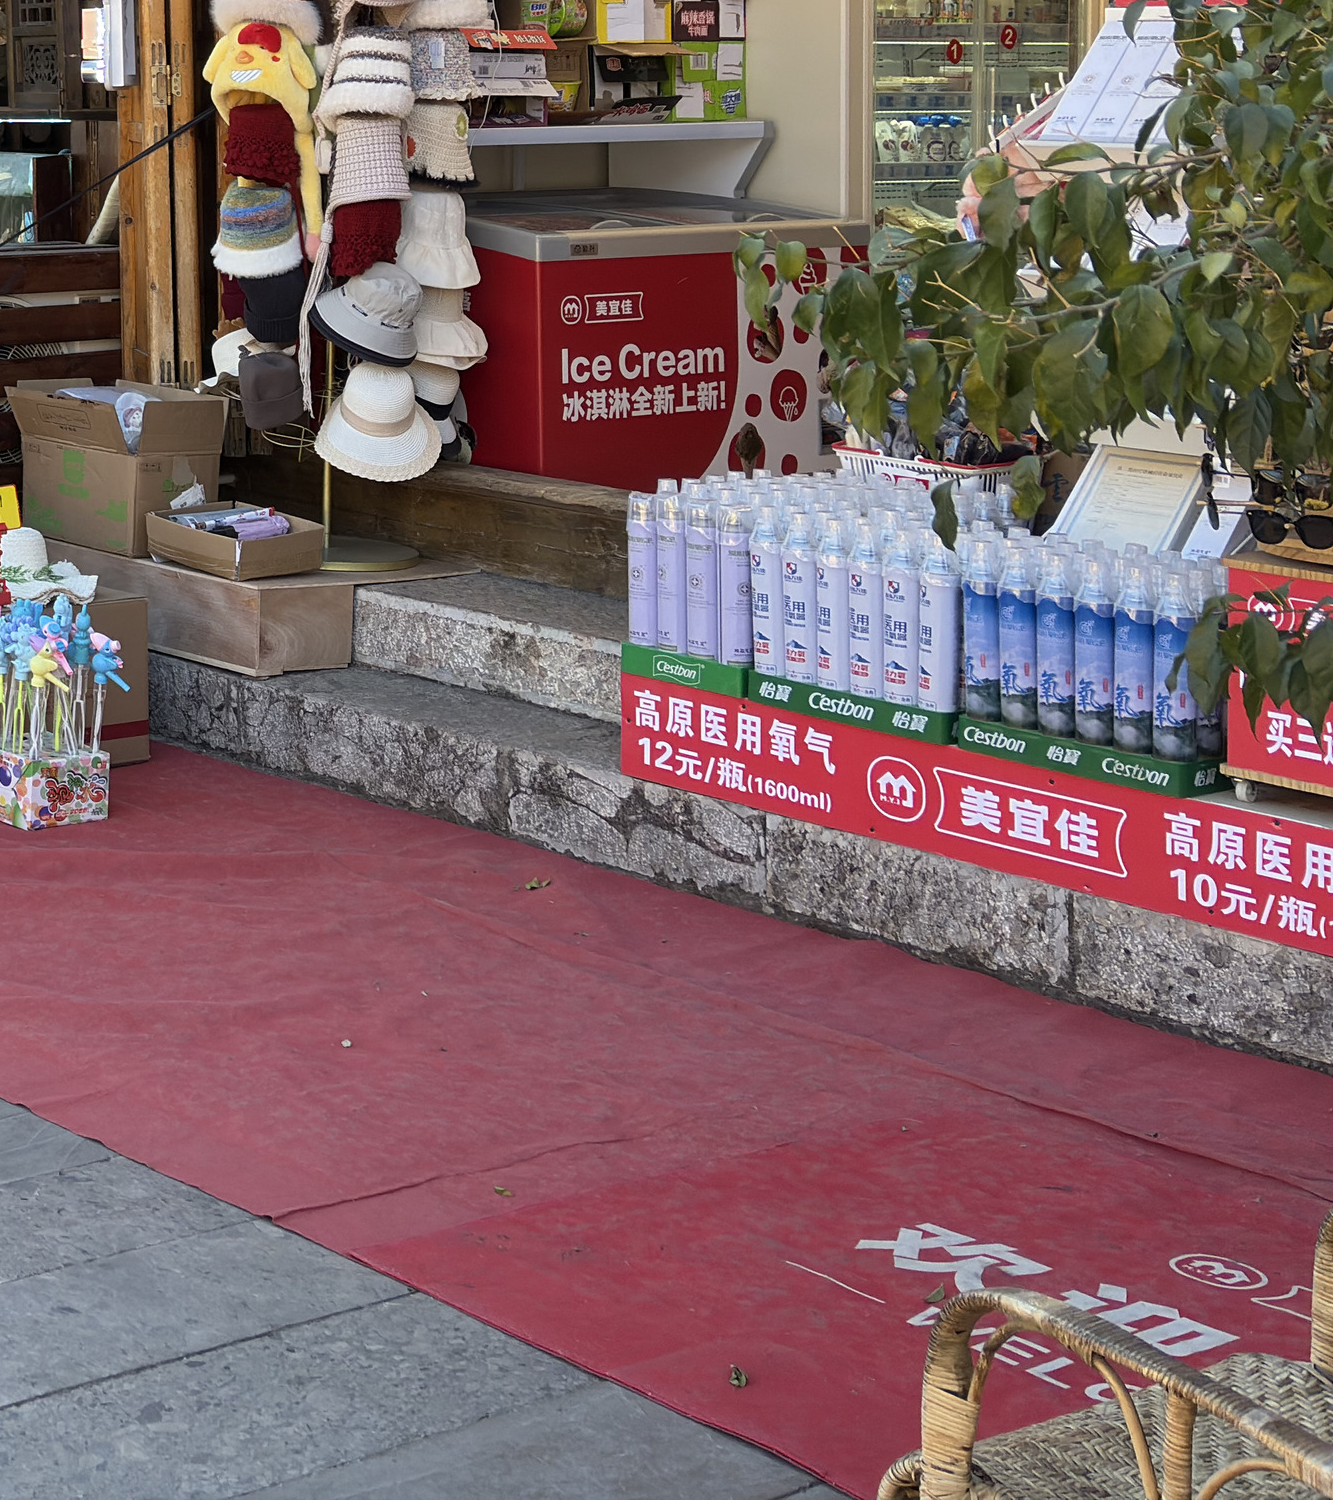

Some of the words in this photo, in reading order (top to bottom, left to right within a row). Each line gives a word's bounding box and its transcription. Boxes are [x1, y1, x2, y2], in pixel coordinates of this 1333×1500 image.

[680, 10, 715, 25] 麻辣香锅
[688, 25, 709, 37] 牛肉面
[950, 45, 959, 60] 1
[1004, 28, 1014, 45] 2
[595, 299, 633, 316] 美宜佳
[561, 348, 612, 384] Ice
[618, 343, 725, 380] Cream
[562, 380, 726, 422] 冰淇淋全新上新!
[1040, 670, 1069, 706] 氧
[1077, 678, 1106, 713] 氧
[1114, 683, 1140, 719] 氧
[1155, 692, 1183, 728] 氧
[633, 688, 836, 775] 高原医用氧气
[637, 737, 833, 814] 12元/瓶(1600ml)
[959, 786, 1100, 858] 美宜佳
[1163, 812, 1333, 893] 高原医用
